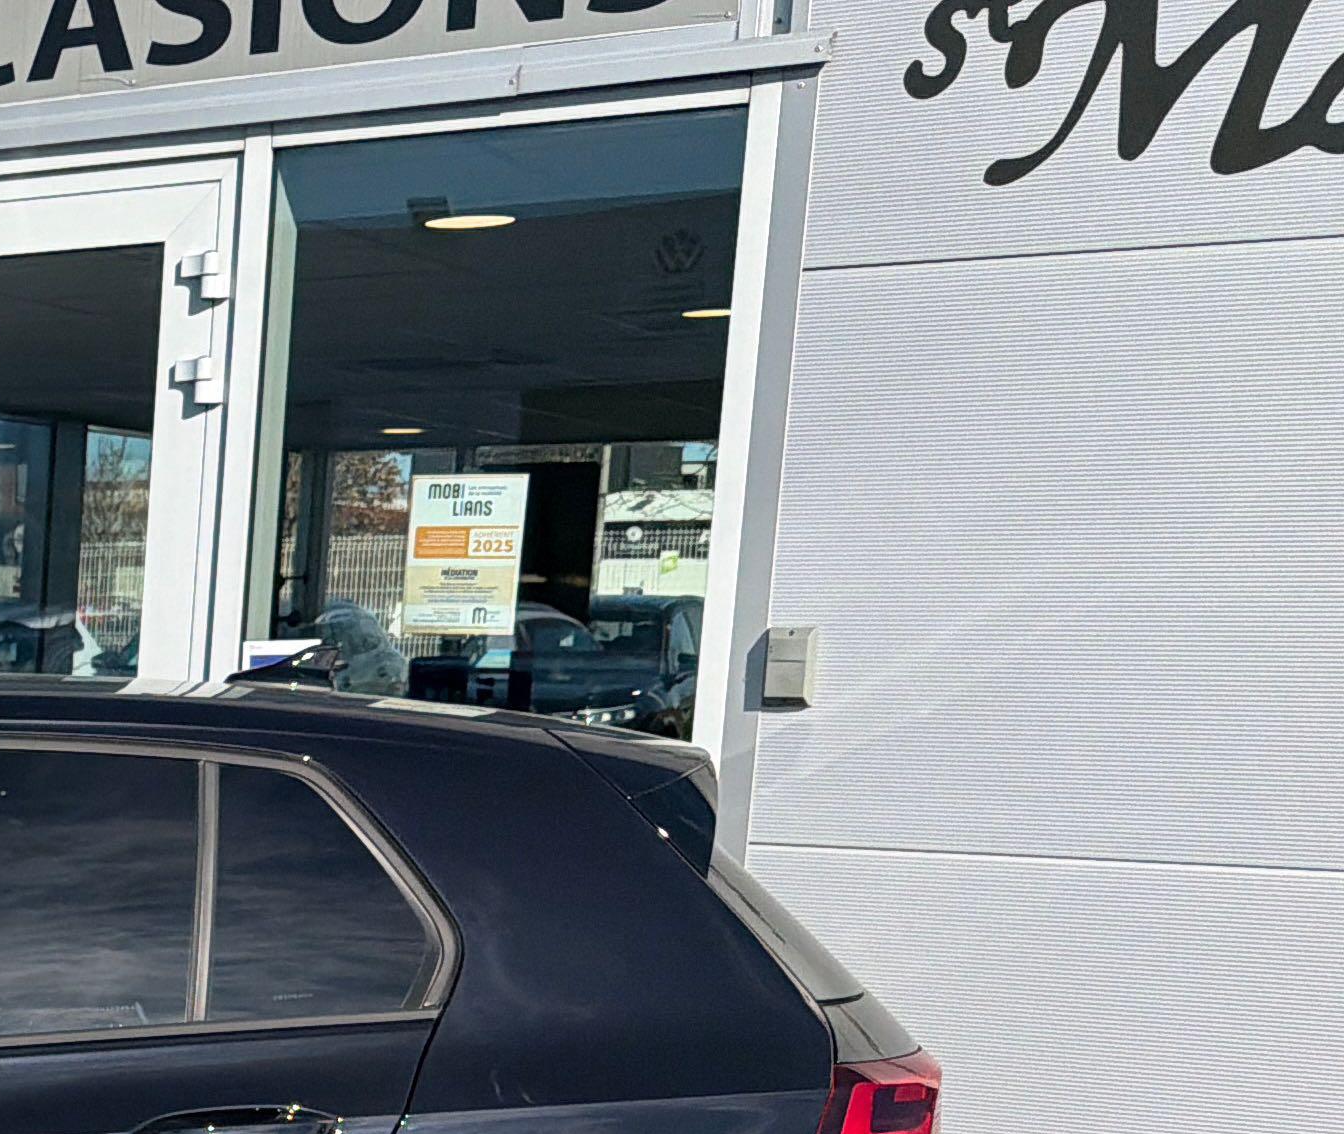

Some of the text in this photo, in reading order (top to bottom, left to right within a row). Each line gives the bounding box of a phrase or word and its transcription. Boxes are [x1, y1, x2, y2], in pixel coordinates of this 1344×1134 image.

[428, 483, 466, 500] MOBI
[452, 500, 493, 517] LIANS
[472, 539, 514, 552] 2025
